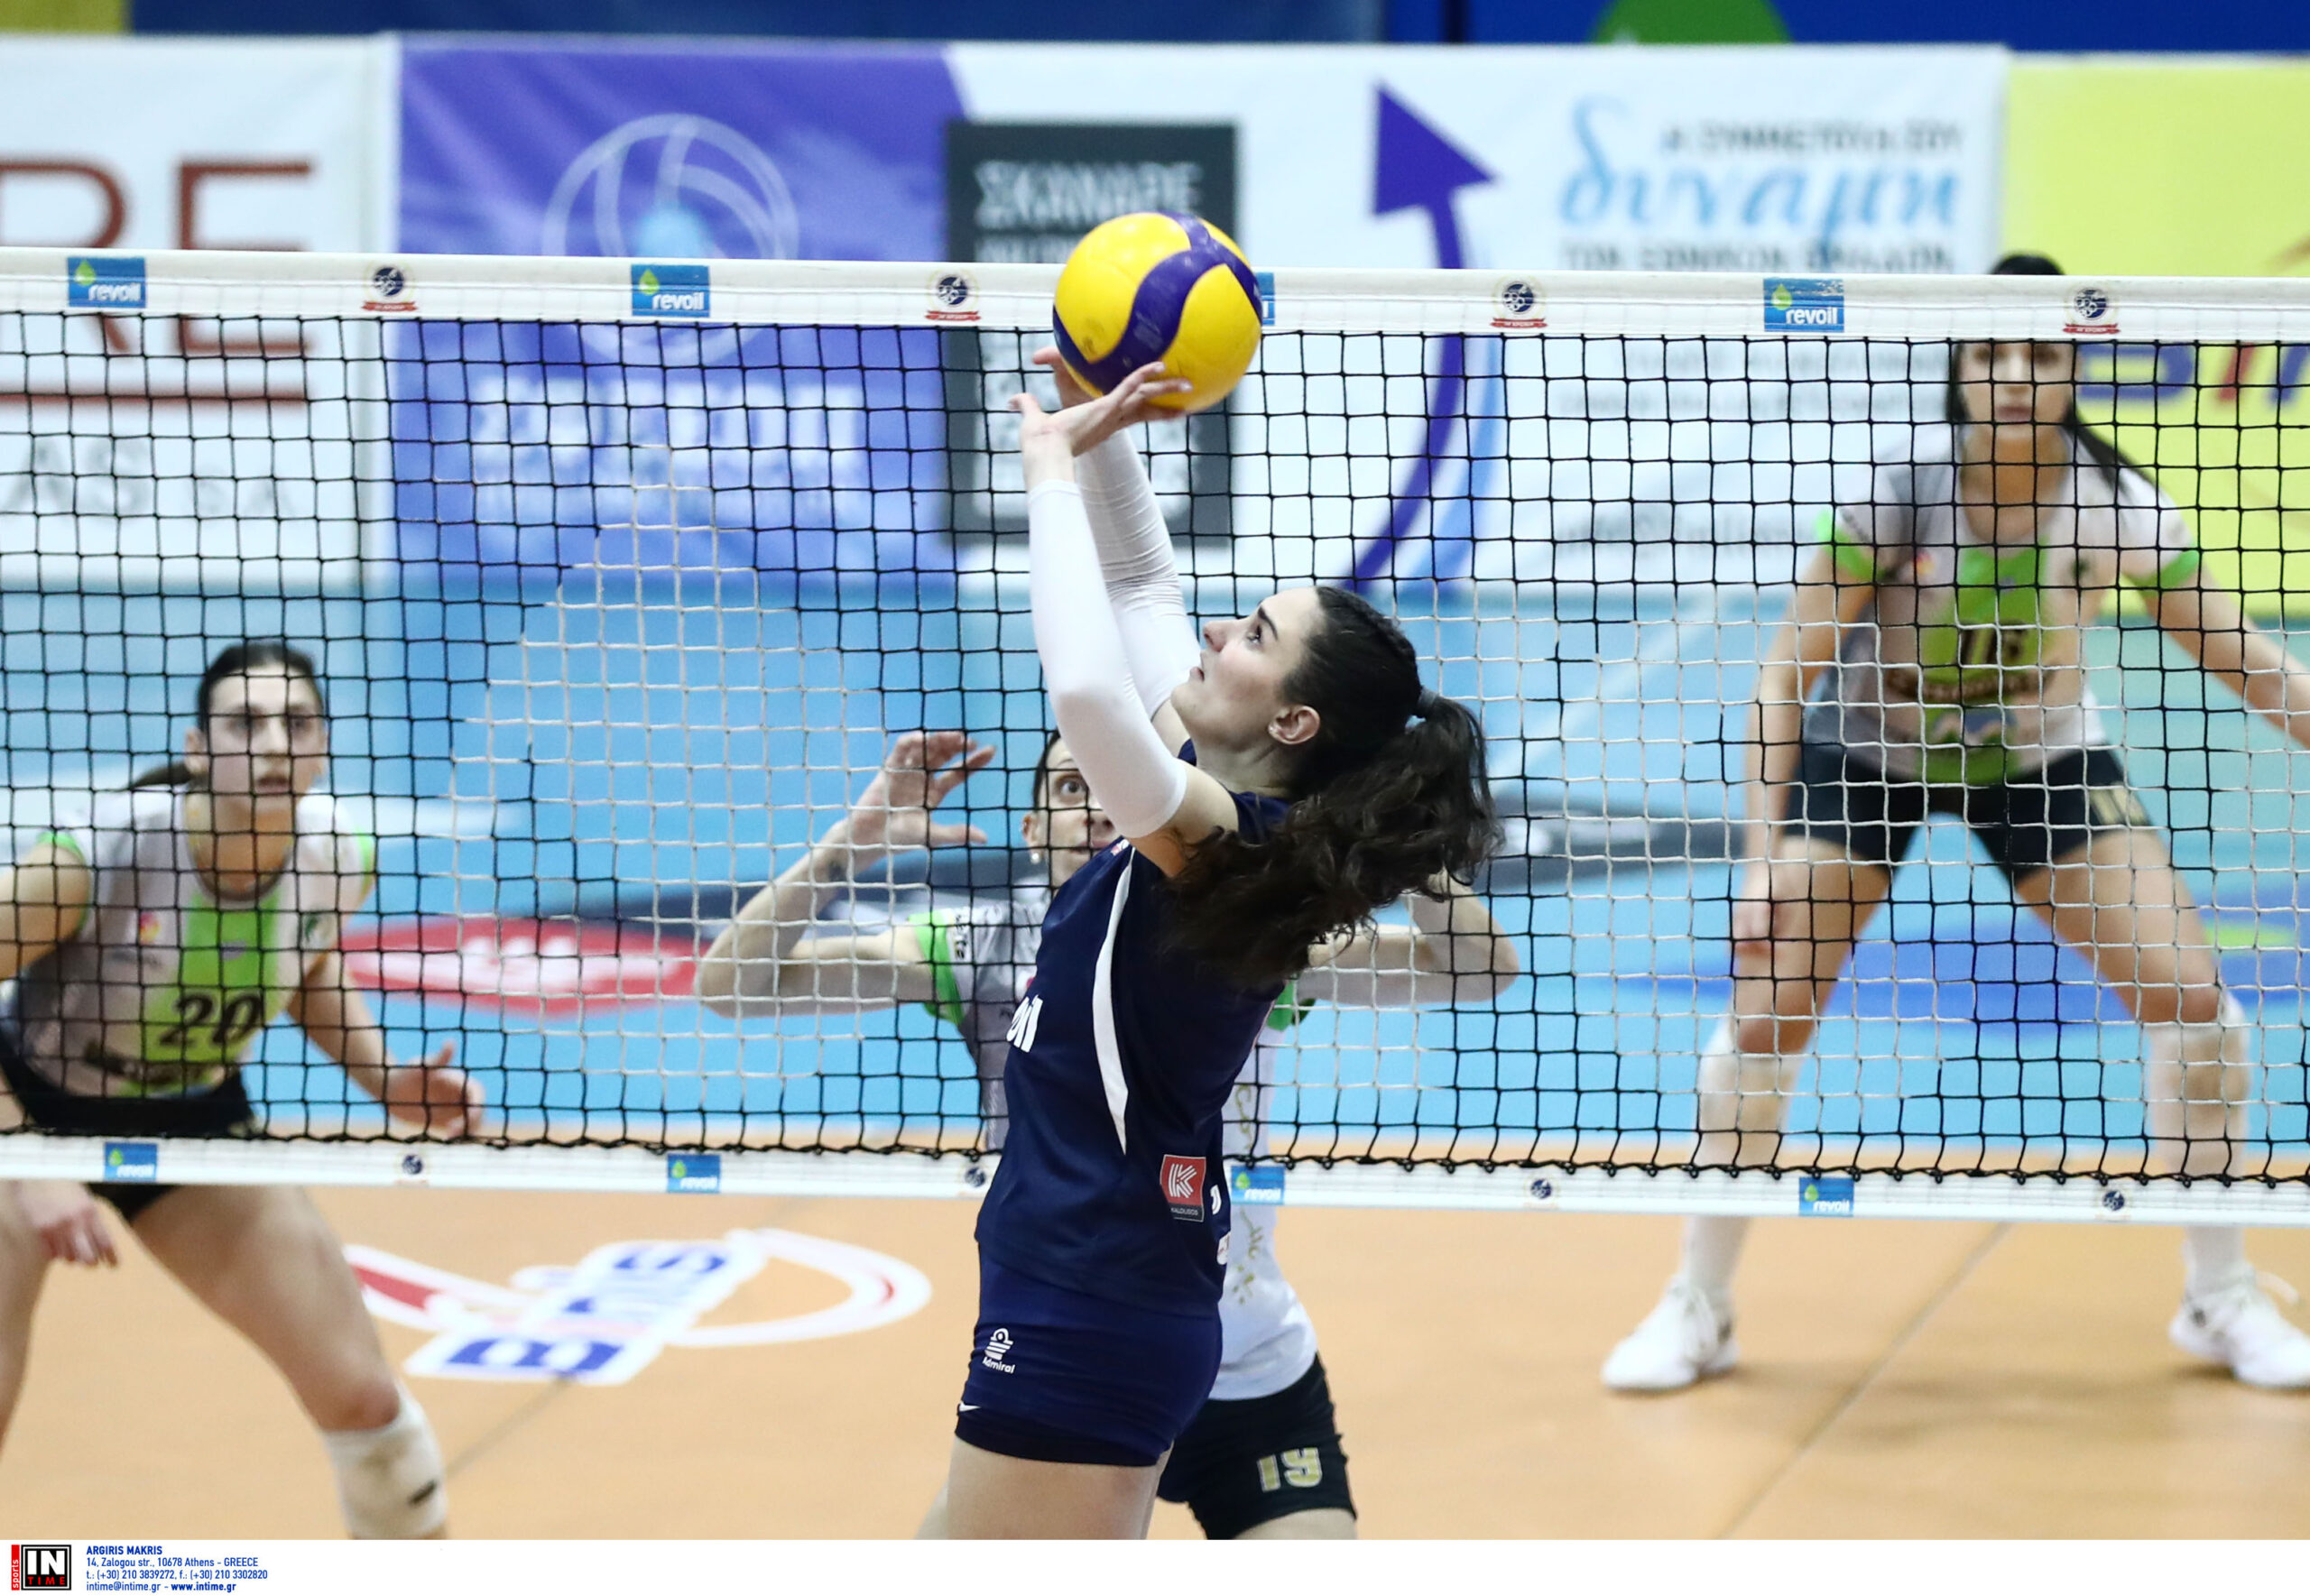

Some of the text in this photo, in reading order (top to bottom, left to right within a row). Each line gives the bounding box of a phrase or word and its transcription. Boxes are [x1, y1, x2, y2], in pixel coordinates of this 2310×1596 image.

[88, 282, 142, 301] revoil
[652, 291, 705, 310] revoil
[1786, 307, 1838, 325] revoil
[160, 992, 262, 1047] 20
[1813, 1198, 1851, 1213] revoil
[982, 1356, 1016, 1374] Admiral
[1256, 1446, 1323, 1493] 19
